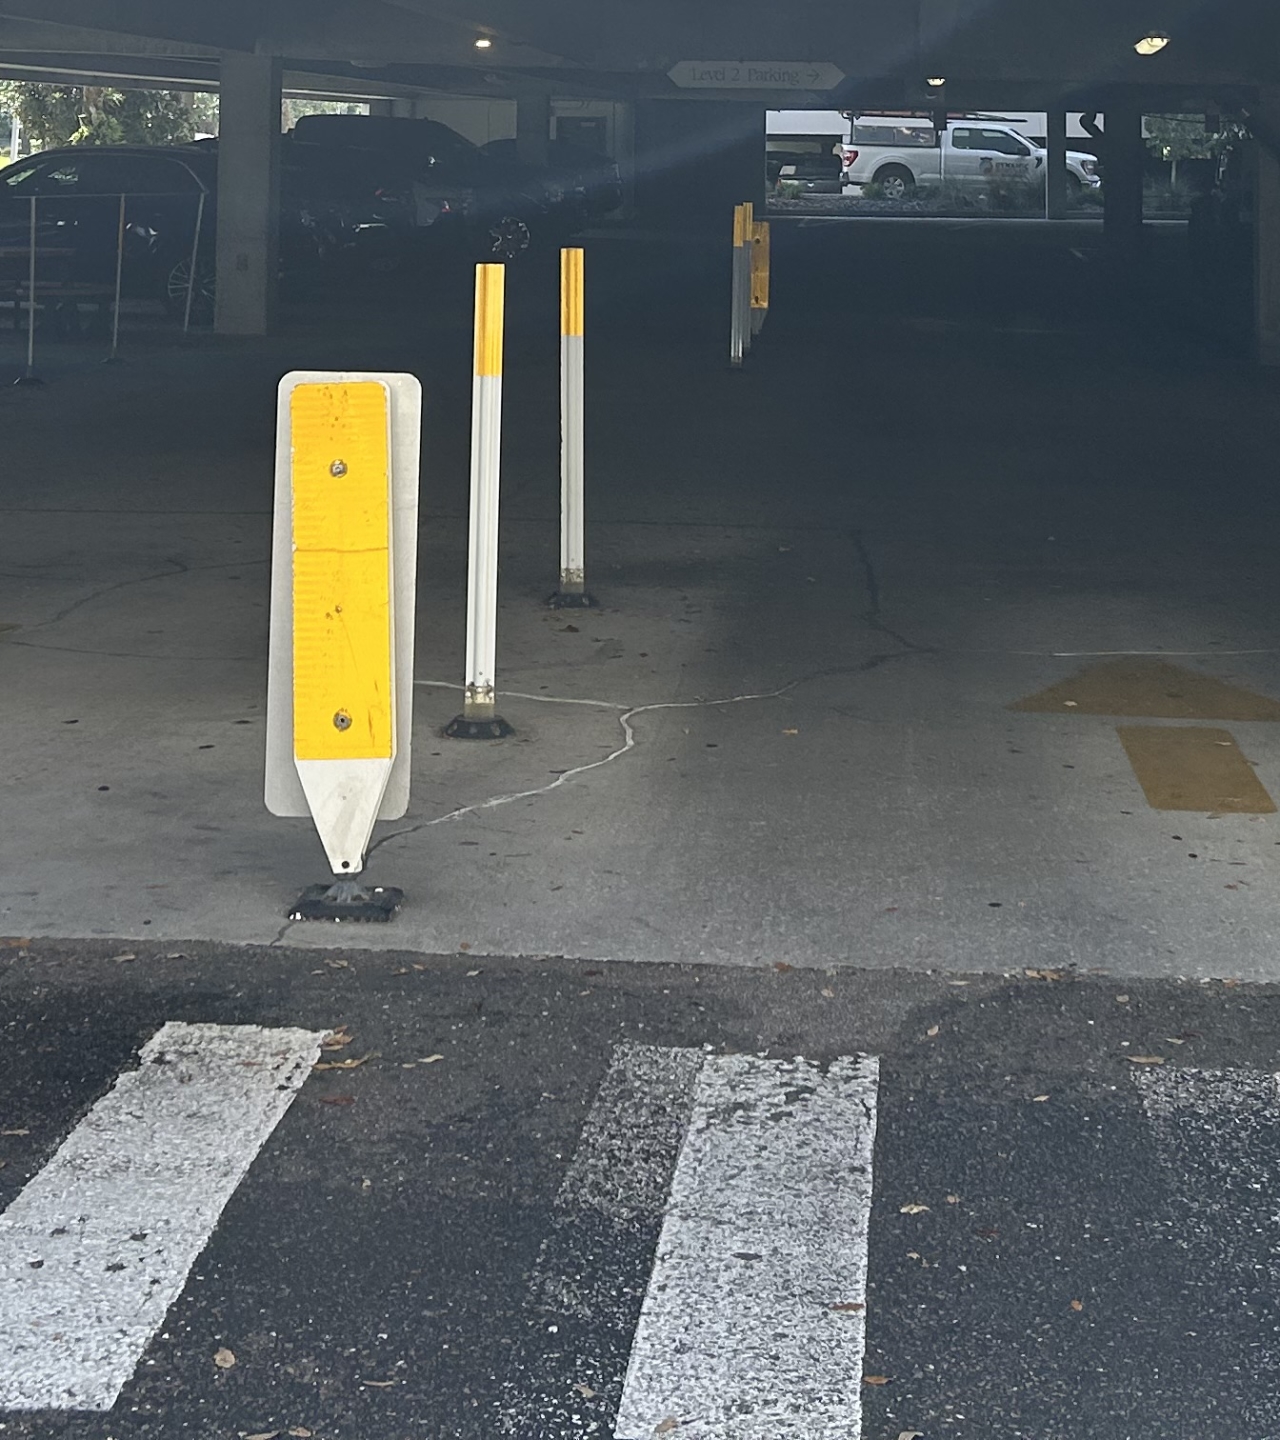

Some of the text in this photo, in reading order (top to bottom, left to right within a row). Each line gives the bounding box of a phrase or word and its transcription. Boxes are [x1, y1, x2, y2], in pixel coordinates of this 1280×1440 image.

[691, 67, 800, 86] Level 2 Parking
